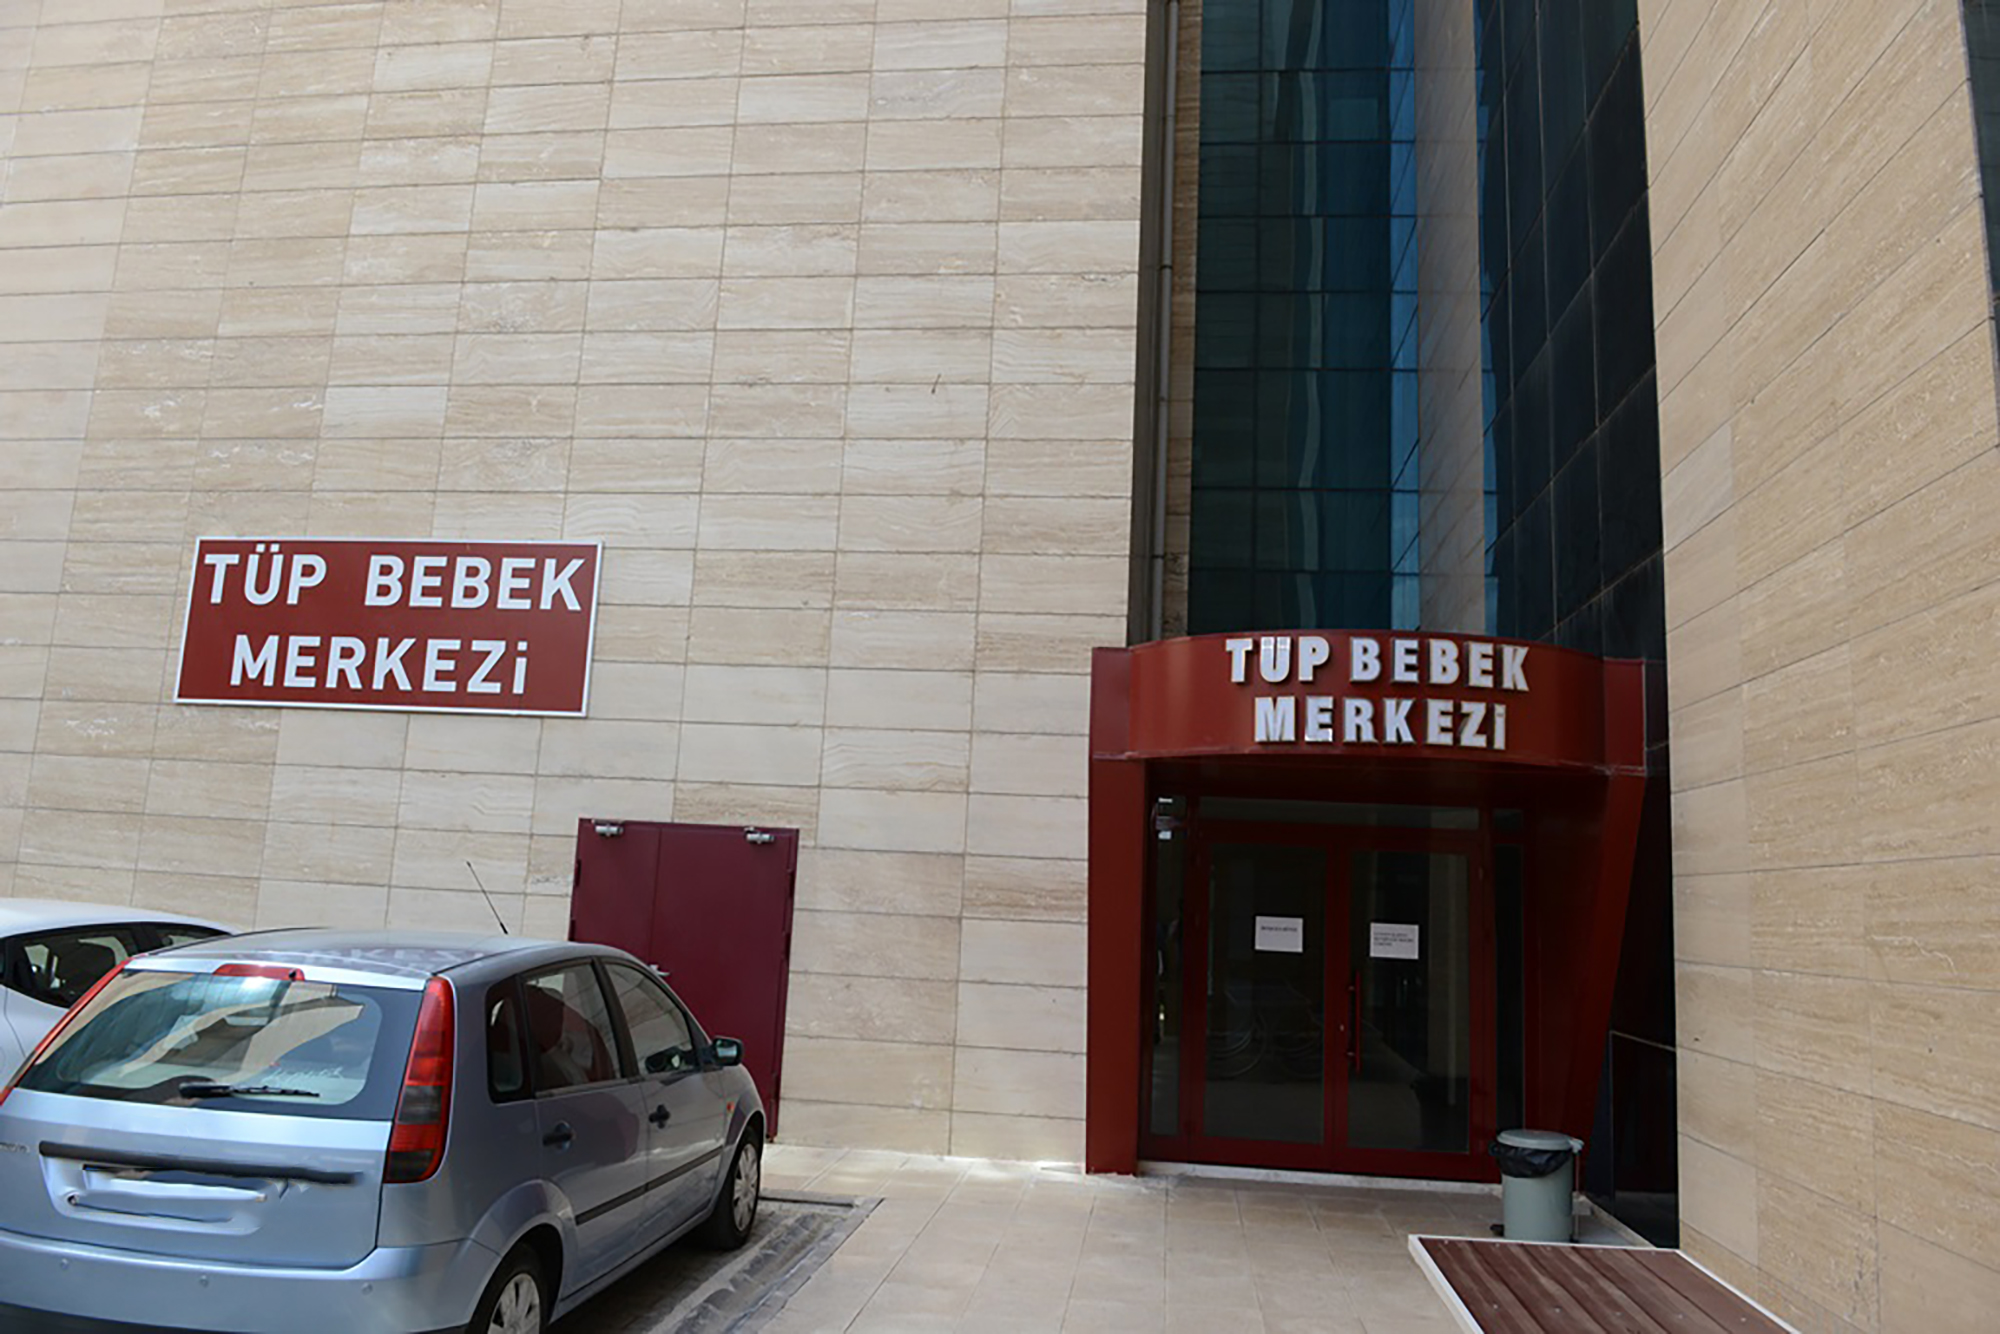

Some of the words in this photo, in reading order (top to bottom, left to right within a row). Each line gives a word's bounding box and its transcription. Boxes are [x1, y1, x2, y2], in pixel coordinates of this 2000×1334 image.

[204, 544, 326, 605] TÜP
[364, 555, 585, 611] BEBEK
[1225, 636, 1329, 683] TÜP
[1350, 638, 1529, 691] BEBEK
